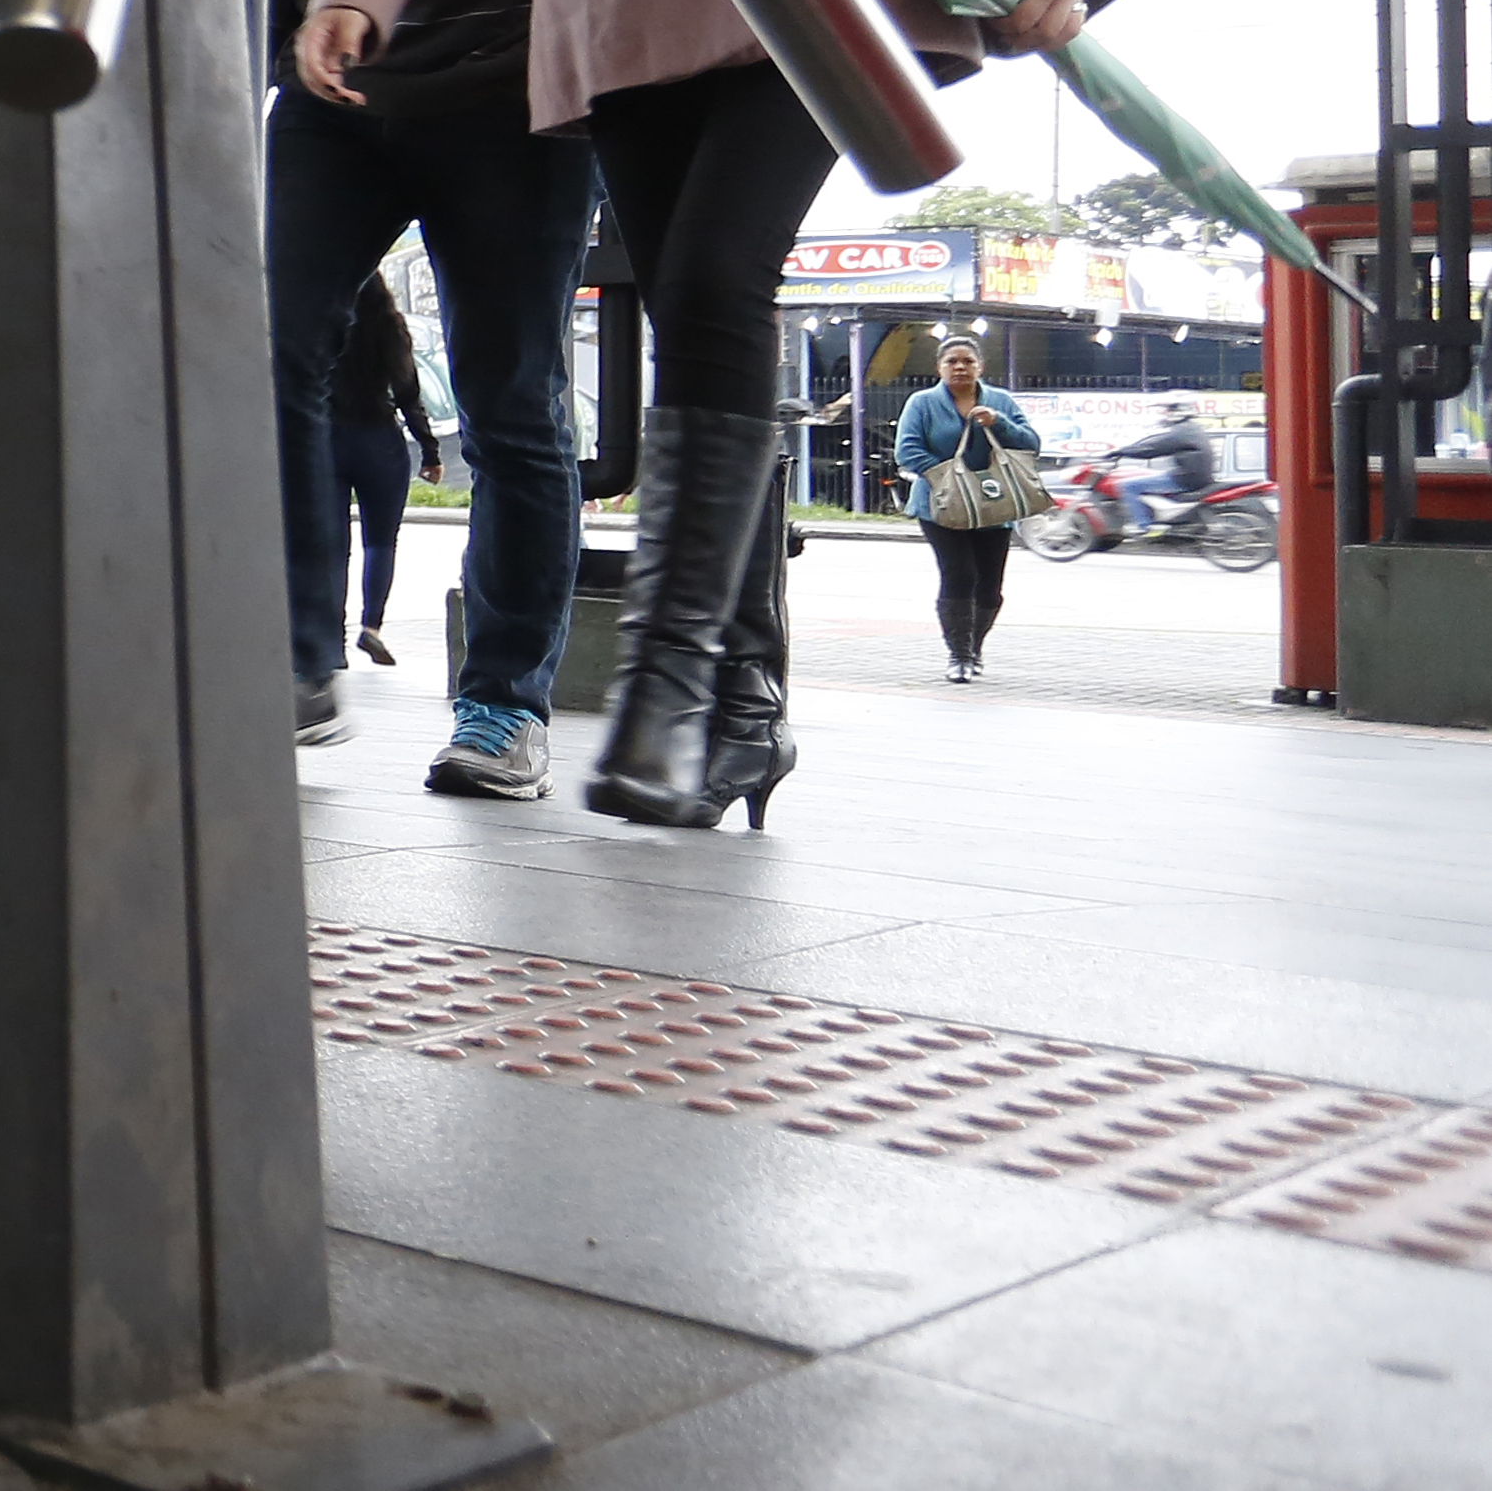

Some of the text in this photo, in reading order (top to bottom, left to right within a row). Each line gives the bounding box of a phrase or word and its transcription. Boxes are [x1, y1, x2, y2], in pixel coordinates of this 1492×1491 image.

[838, 247, 903, 269] CAR
[777, 282, 822, 296] antia
[827, 282, 849, 295] de
[1016, 399, 1074, 415] ESEJA
[1231, 398, 1265, 415] SE
